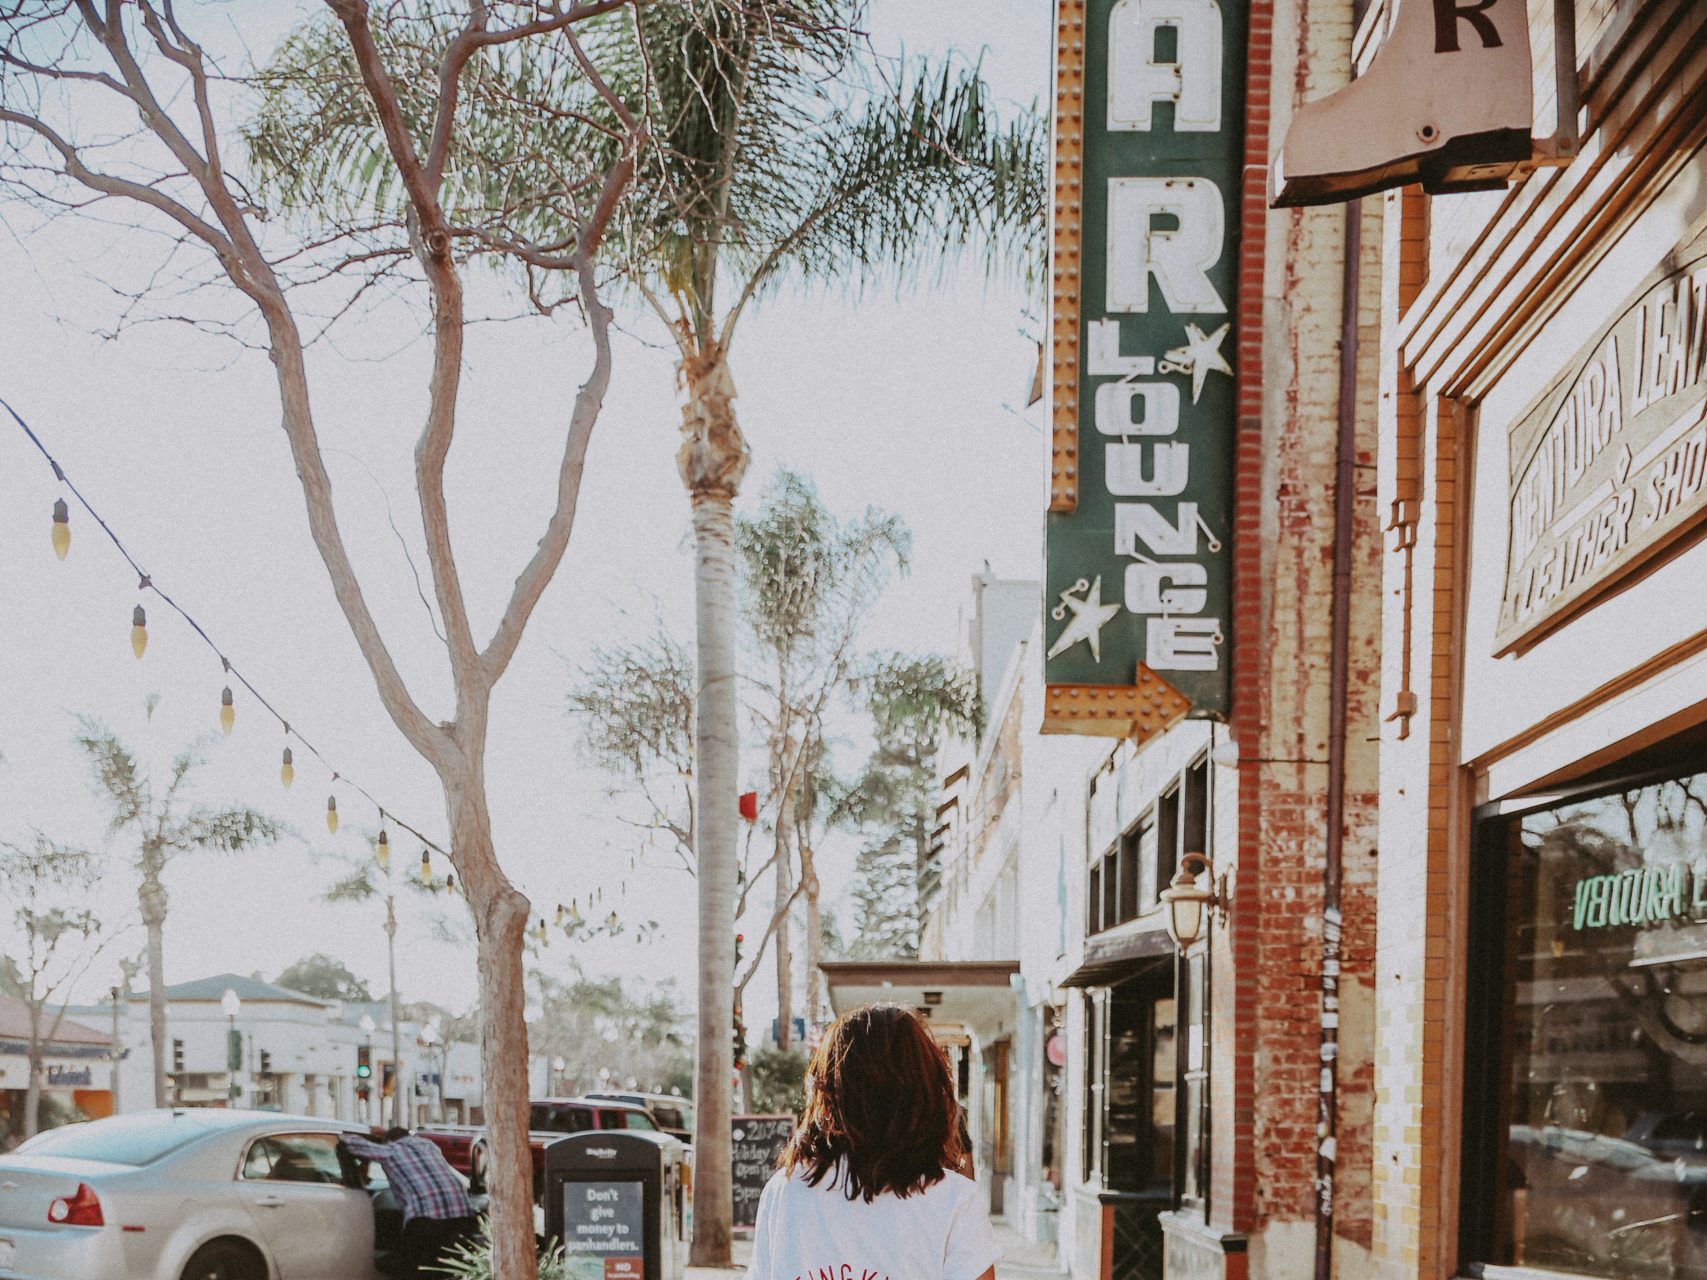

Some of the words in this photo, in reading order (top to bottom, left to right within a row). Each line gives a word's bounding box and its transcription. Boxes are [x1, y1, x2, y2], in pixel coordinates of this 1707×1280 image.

[1513, 334, 1624, 575] VENTURA
[1630, 264, 1707, 422] LEAT
[1086, 318, 1221, 672] LOUNGE
[1516, 486, 1637, 620] LEATHER
[1573, 862, 1682, 931] VENTURA
[586, 1187, 619, 1202] Don't
[590, 1205, 615, 1222] give
[576, 1224, 615, 1238] money
[615, 1222, 630, 1235] to
